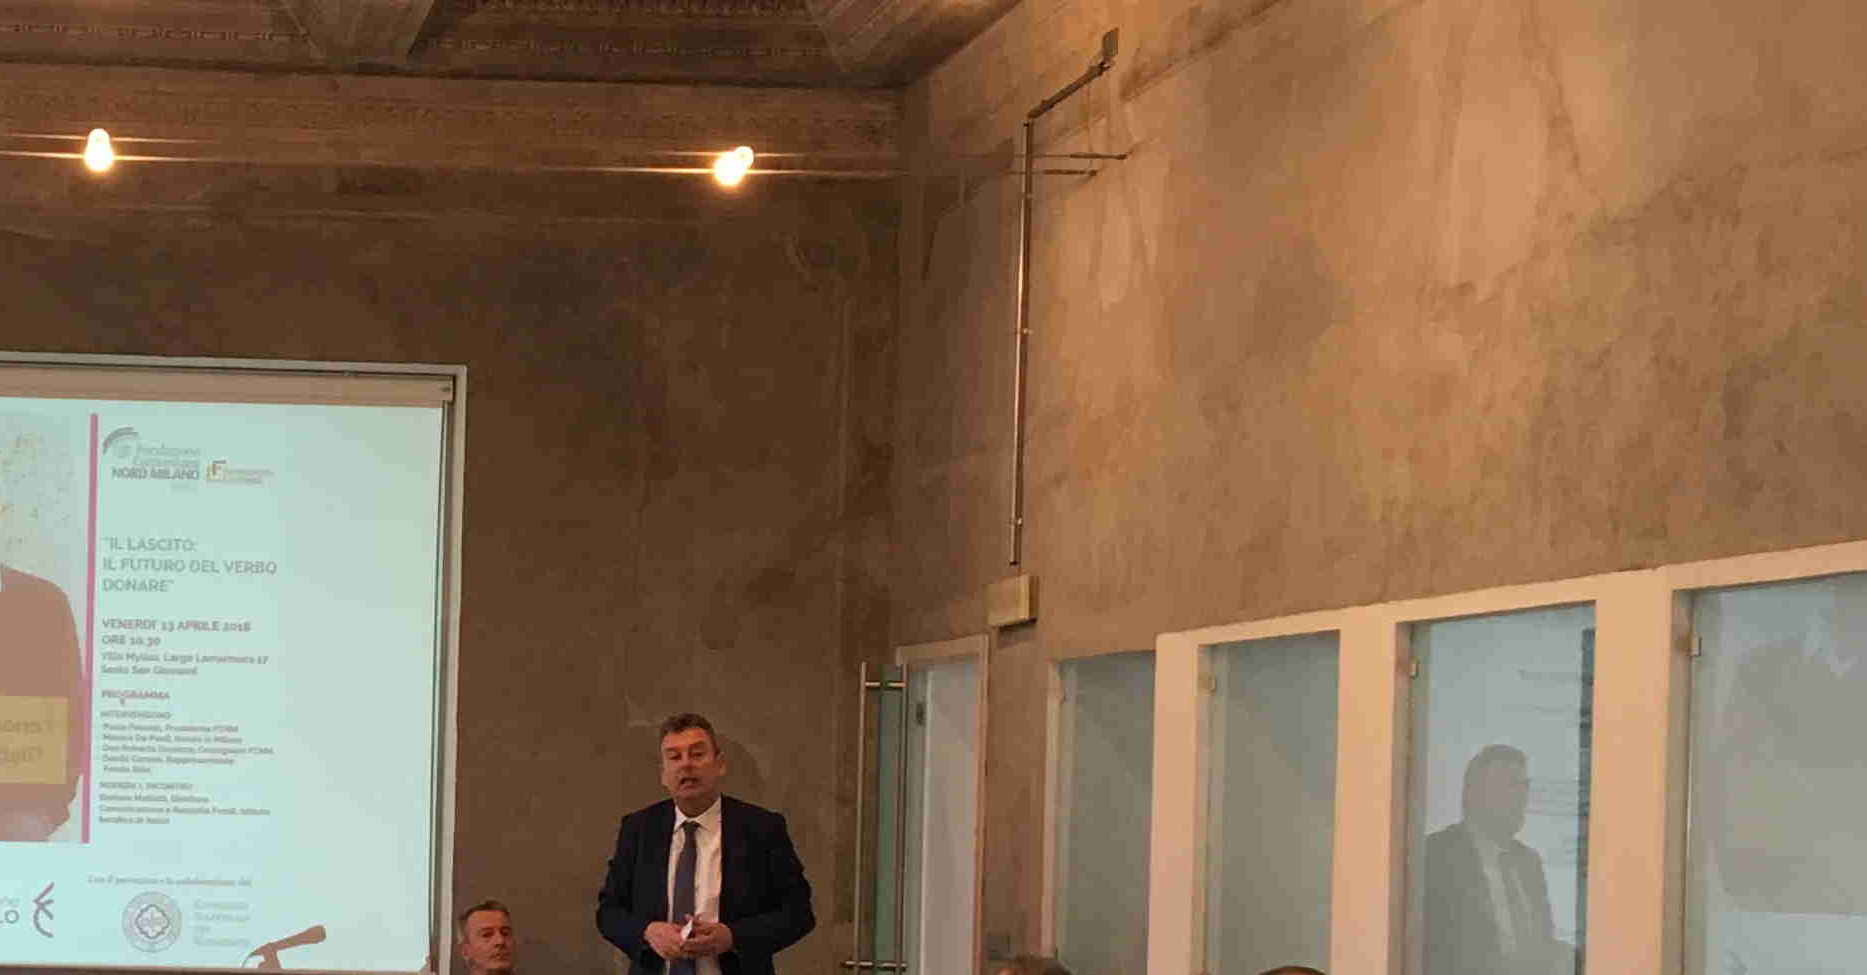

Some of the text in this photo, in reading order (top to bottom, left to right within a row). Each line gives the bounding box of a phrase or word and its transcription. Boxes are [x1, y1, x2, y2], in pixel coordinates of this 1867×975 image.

[127, 537, 198, 552] LASCITO:
[102, 557, 278, 575] IL FUTURO DEL VERBO
[176, 620, 221, 632] APRILE
[101, 634, 127, 646] ORE
